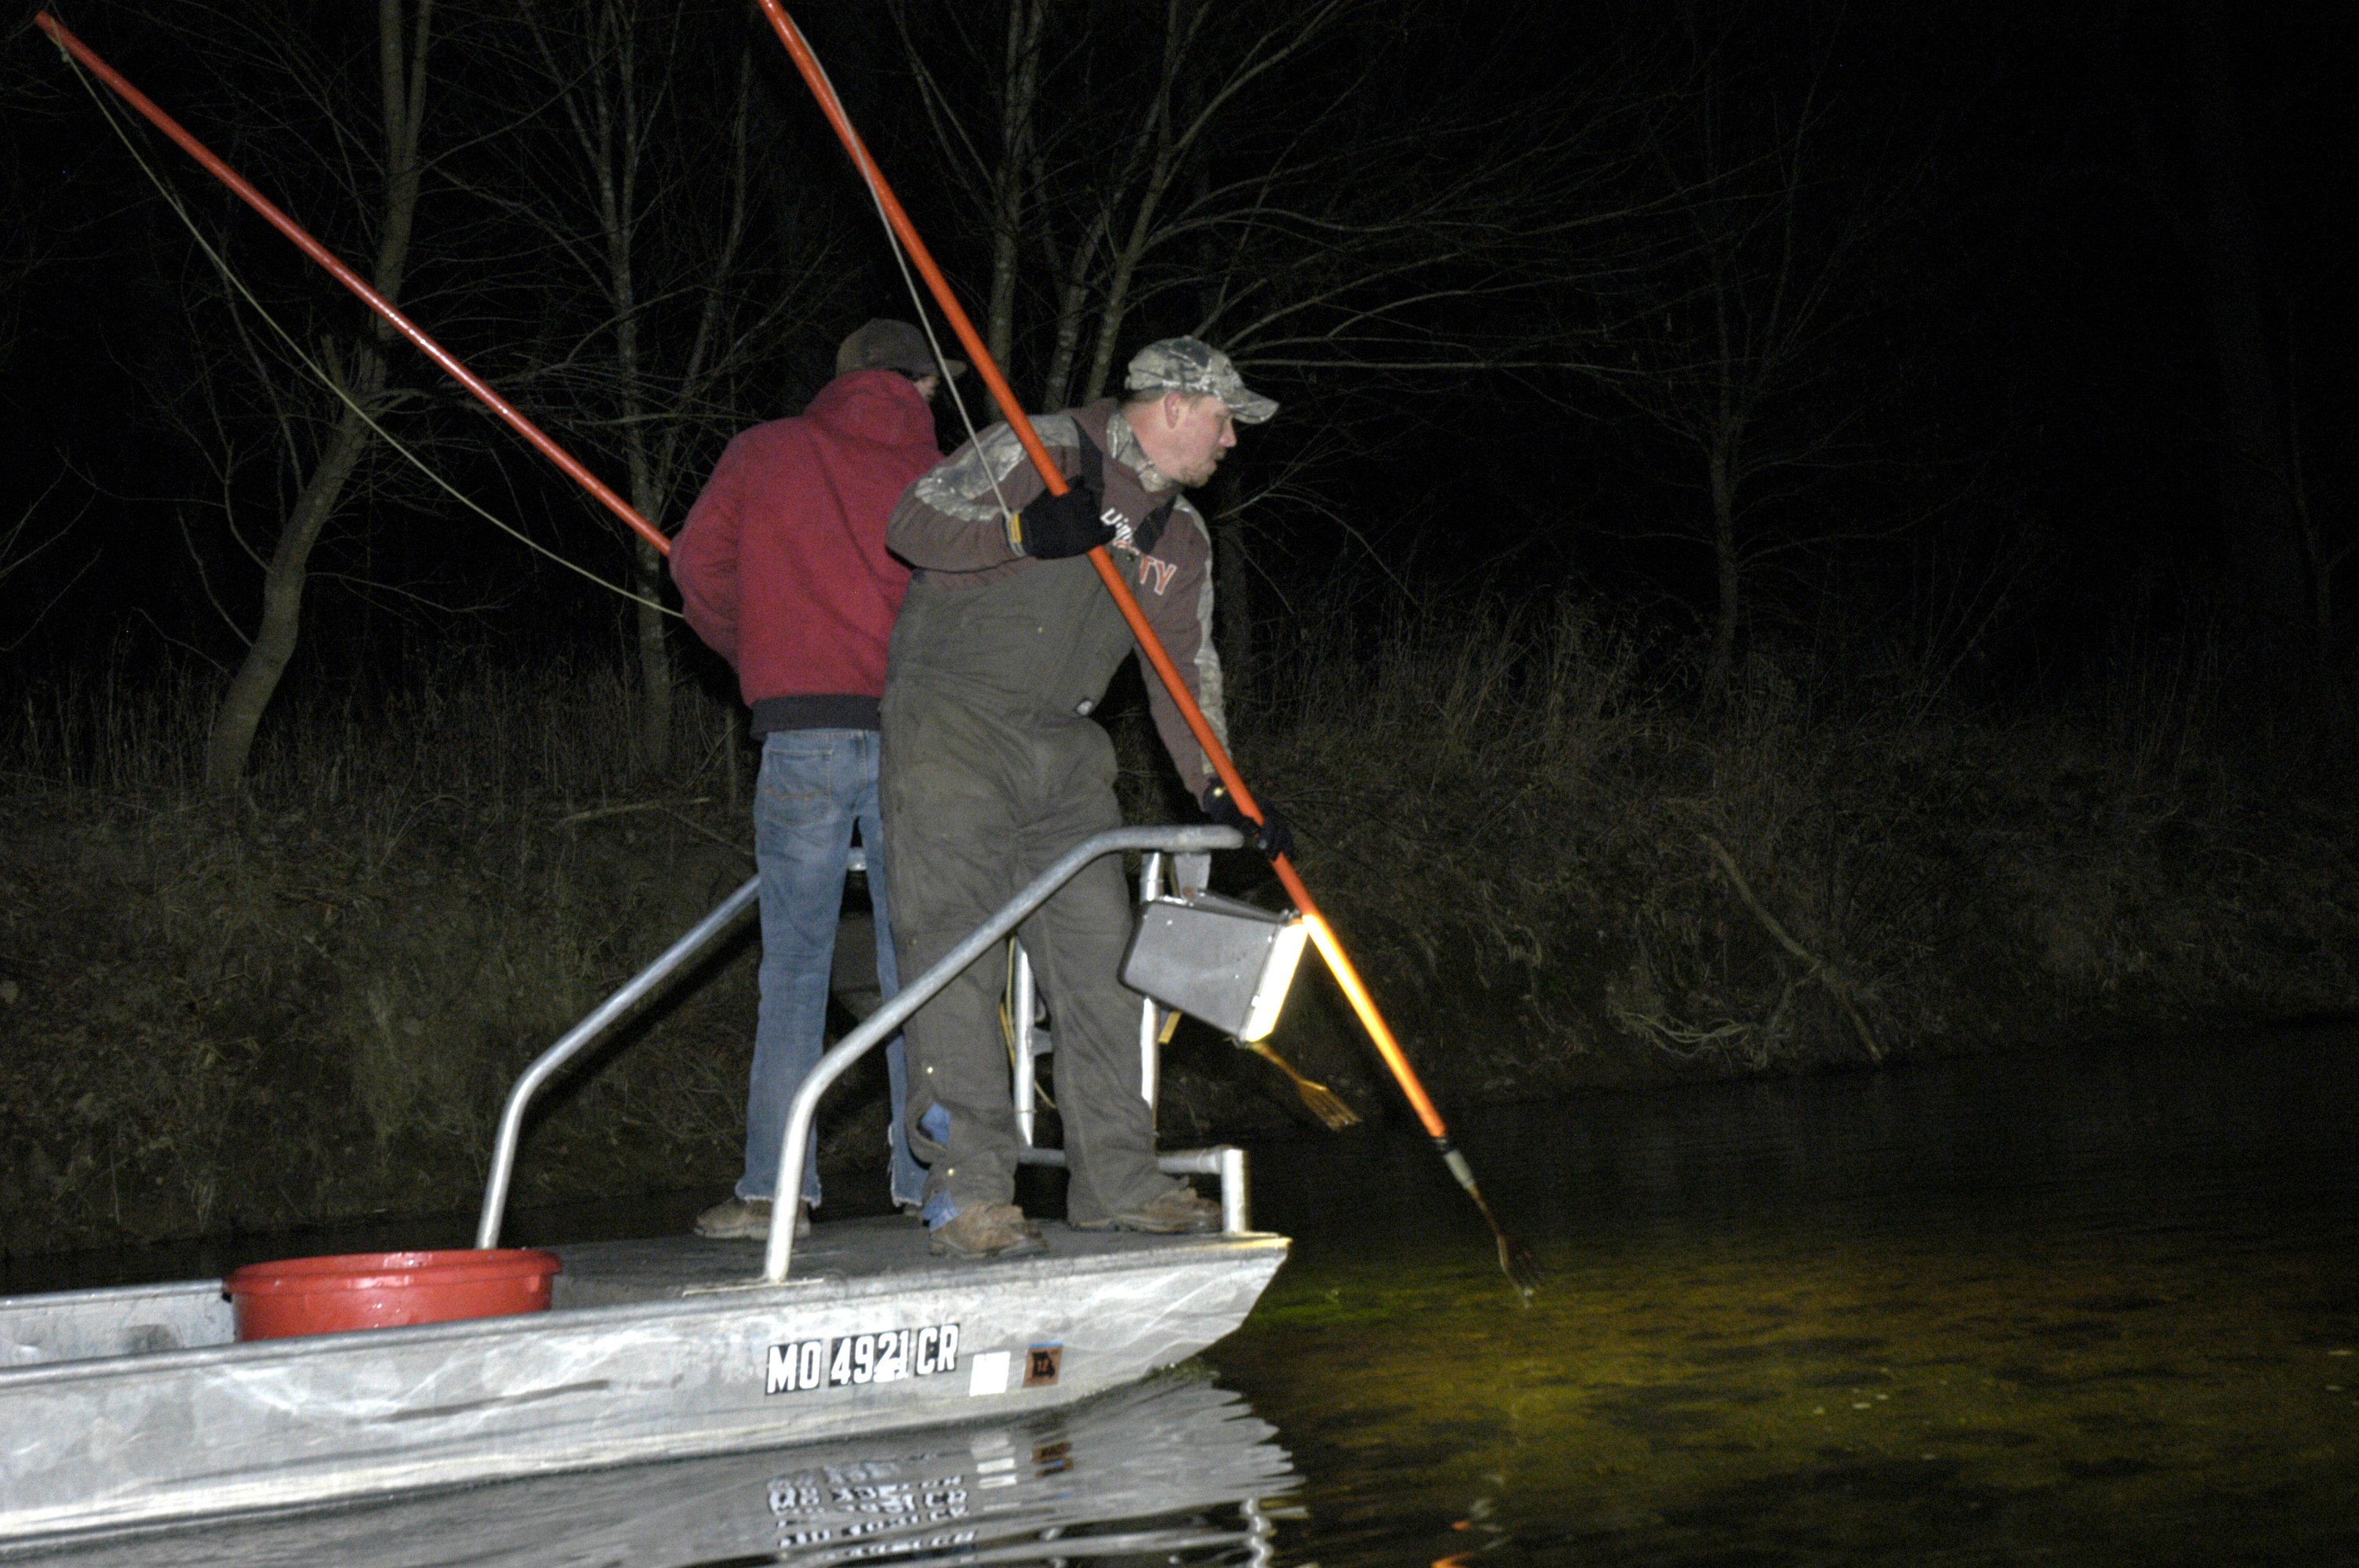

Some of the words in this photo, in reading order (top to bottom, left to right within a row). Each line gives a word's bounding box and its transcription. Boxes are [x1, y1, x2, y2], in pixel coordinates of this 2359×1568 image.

[766, 1341, 821, 1394] MO
[831, 1330, 909, 1385] 4921
[915, 1323, 960, 1375] CR
